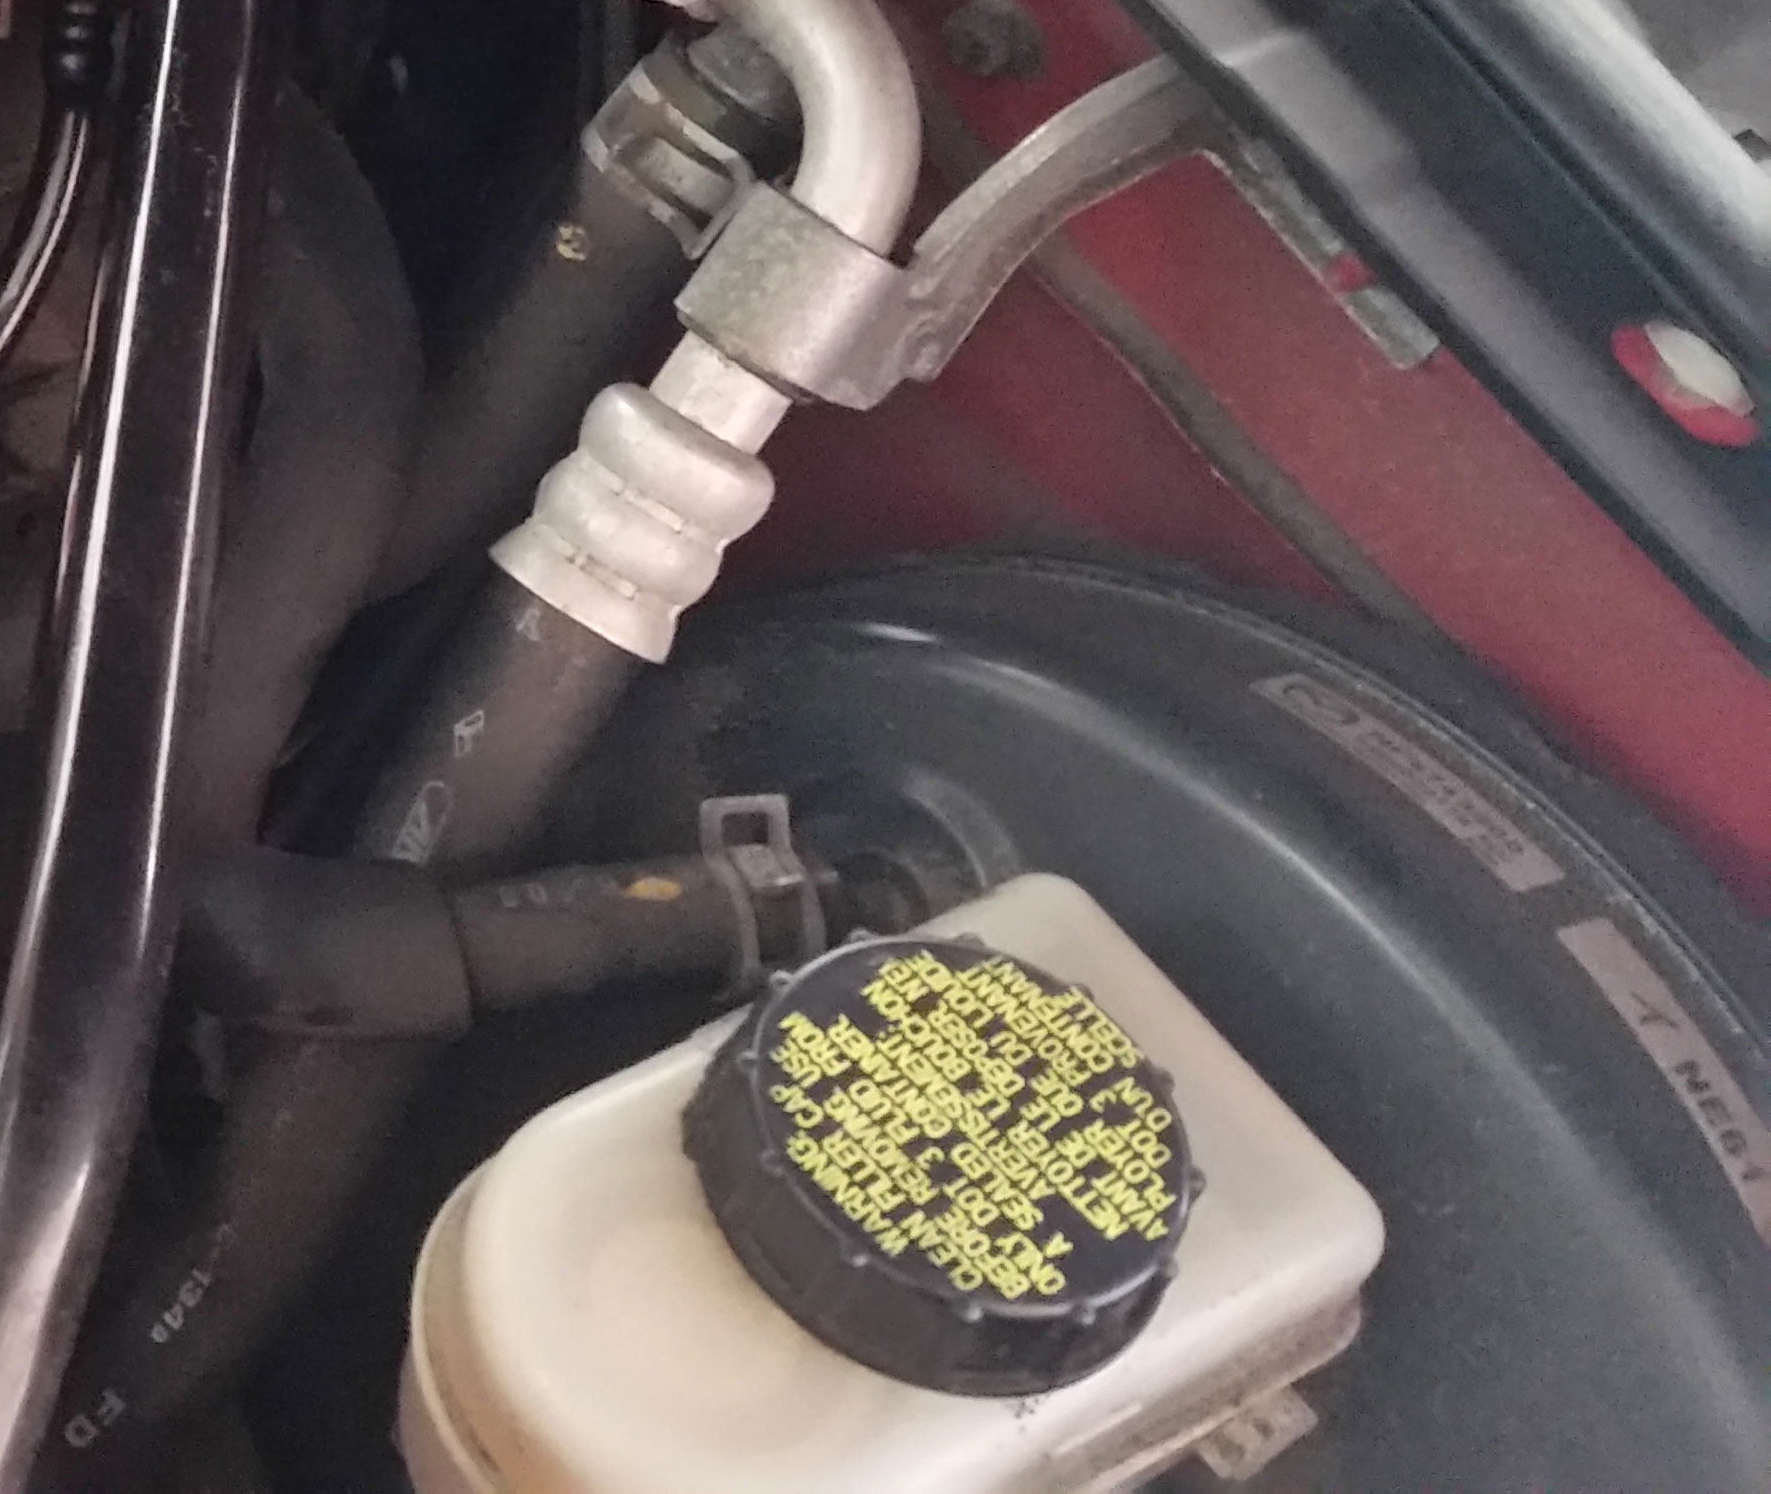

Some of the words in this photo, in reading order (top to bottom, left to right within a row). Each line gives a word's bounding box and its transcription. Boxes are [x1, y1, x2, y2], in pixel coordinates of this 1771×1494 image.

[779, 1011, 852, 1077] FROM
[861, 975, 973, 1084] BOUCHON
[953, 964, 1092, 1090] PROVENANT
[986, 1026, 1035, 1069] DU
[771, 1038, 825, 1091] USE
[1030, 1066, 1085, 1118] QUE
[770, 1086, 826, 1132] CAP
[844, 1077, 922, 1147] FLUID
[964, 1078, 1011, 1121] LE
[1018, 1094, 1063, 1133] LE
[1088, 1088, 1118, 1112] 3
[817, 1130, 908, 1212] FILLER
[913, 1146, 945, 1172] 3
[1053, 1129, 1099, 1169] DE
[1079, 1119, 1176, 1212] PLOYER
[1112, 1116, 1171, 1169] DOT
[784, 1129, 912, 1254] WARNING:
[941, 1175, 1002, 1227] DOT
[948, 1137, 1044, 1231] SEALED
[1003, 1117, 1131, 1239] NETTOYER
[1091, 1169, 1169, 1239] AVANT
[896, 1211, 988, 1289] CLEAN
[930, 1204, 1034, 1299] BEFORE
[993, 1230, 1066, 1295] ONLY
[1041, 1232, 1073, 1259] A
